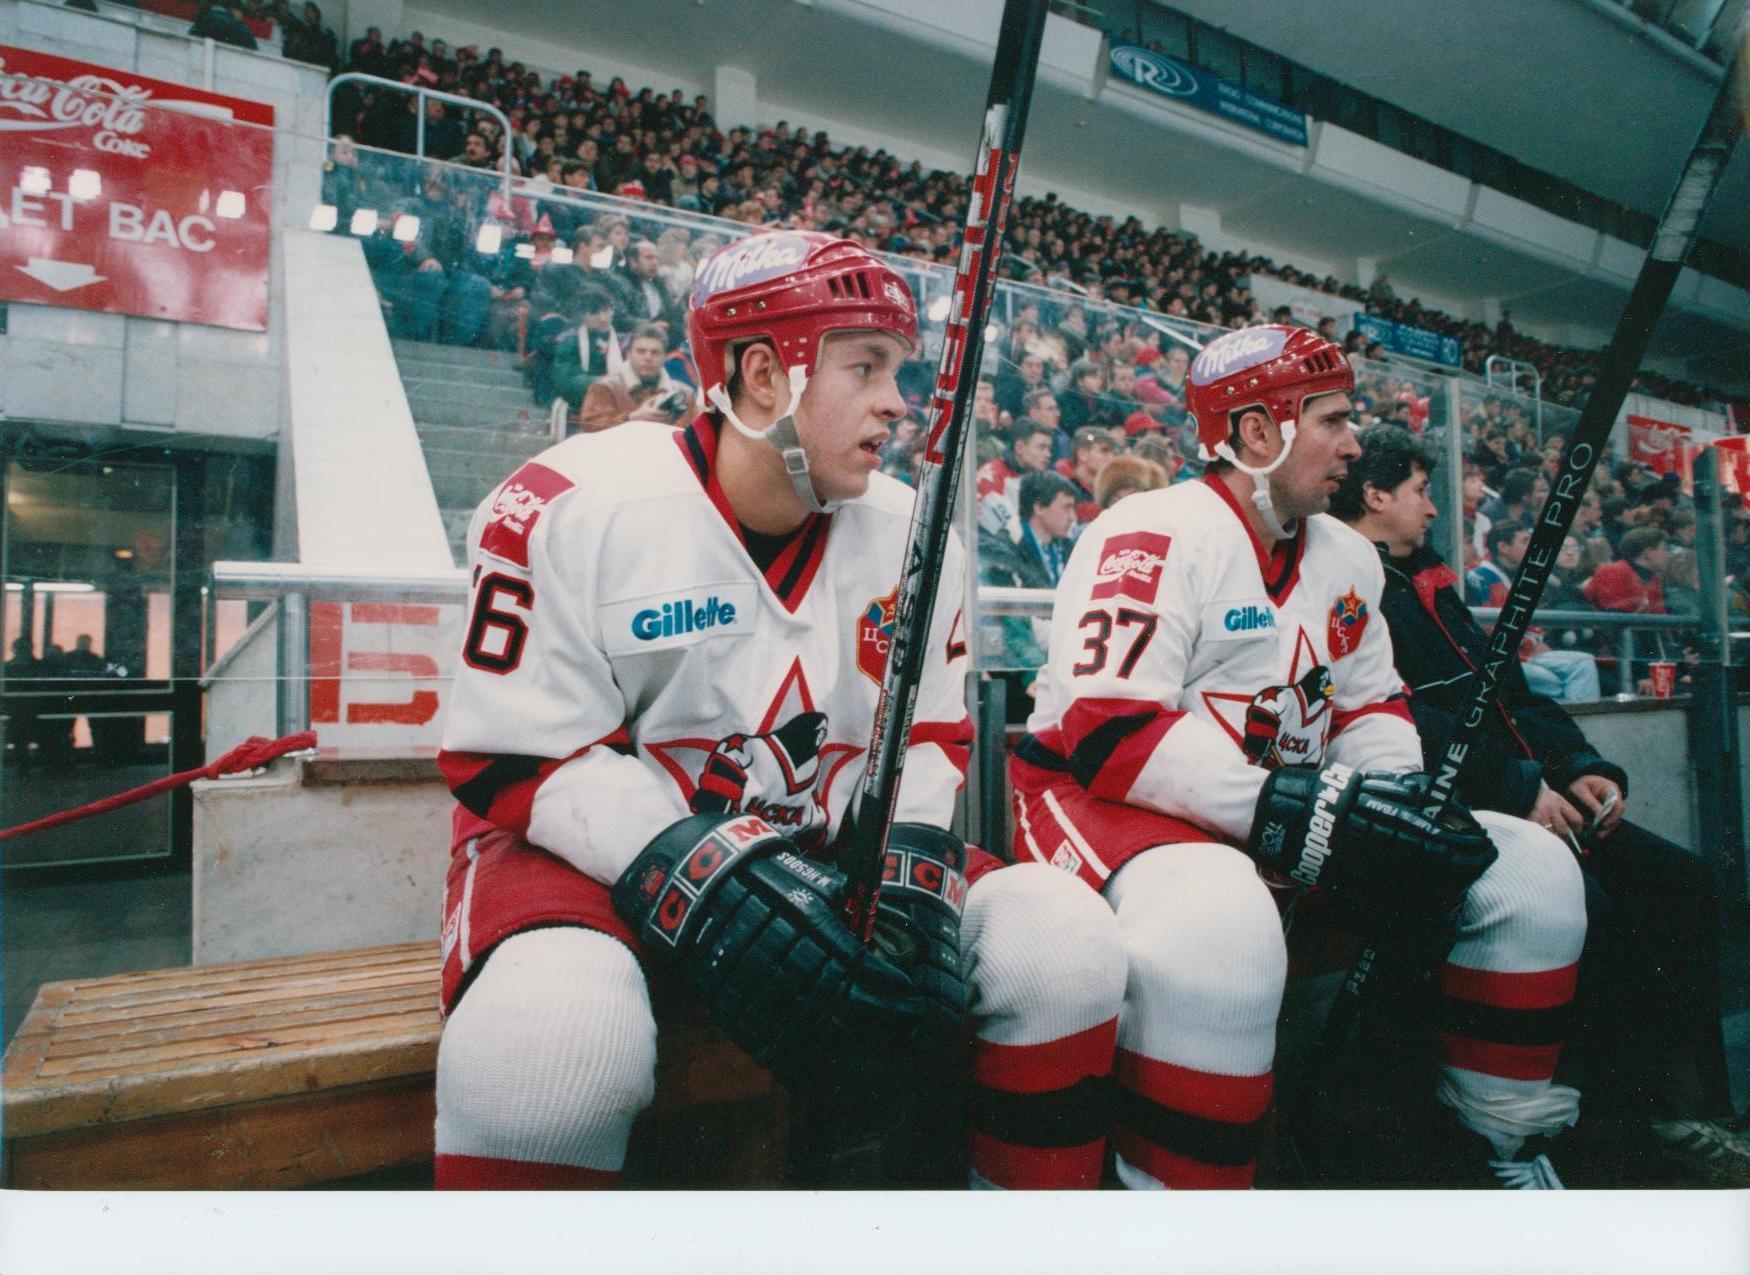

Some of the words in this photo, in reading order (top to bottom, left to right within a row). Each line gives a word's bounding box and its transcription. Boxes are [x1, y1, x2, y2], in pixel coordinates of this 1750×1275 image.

[93, 131, 151, 159] Coke
[0, 186, 87, 231] ЕТ
[702, 240, 800, 292] Milka
[925, 147, 1002, 466] TITAN
[1197, 335, 1274, 379] Milka
[1543, 441, 1594, 529] PRO
[462, 564, 535, 676] 6
[631, 596, 736, 641] Gillette
[863, 626, 891, 654] ЦС
[1073, 607, 1159, 680] 37
[1464, 542, 1553, 729] GRAPHITE
[1279, 731, 1310, 754] ЦСКА
[1290, 798, 1336, 886] Cooper
[659, 818, 775, 931] CCM
